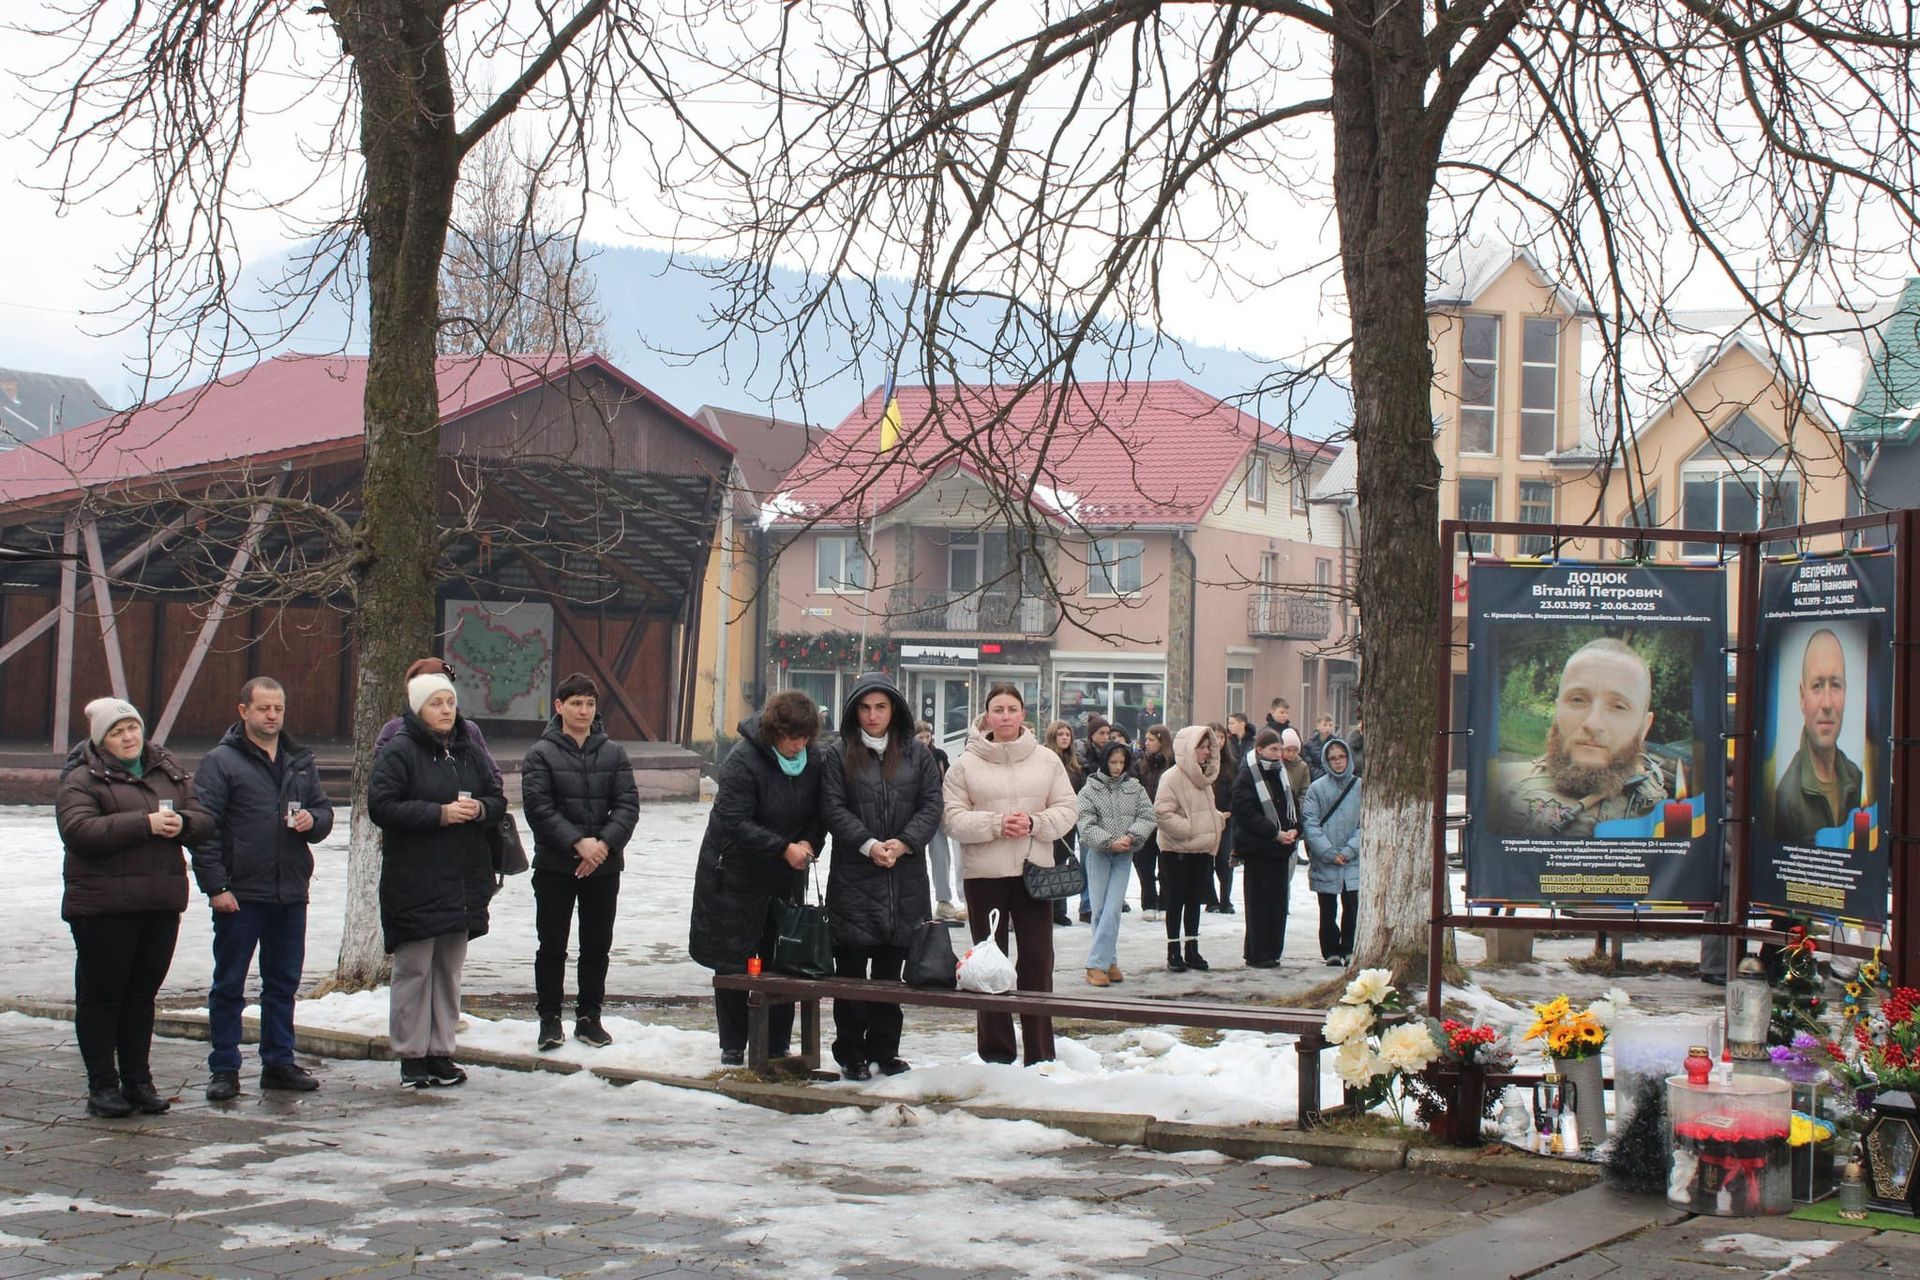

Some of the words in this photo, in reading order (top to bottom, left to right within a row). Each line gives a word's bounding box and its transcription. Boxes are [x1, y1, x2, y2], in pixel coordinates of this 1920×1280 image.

[1800, 563, 1848, 578] ВЕПРЕЙЧУК
[1567, 571, 1627, 585] ДОДЮК
[1532, 584, 1586, 597] Віталій
[1590, 586, 1663, 599] Петрович
[1792, 579, 1821, 593] Віталій
[1822, 579, 1858, 592] Іванович
[1540, 601, 1592, 610] 23.03.1992
[1600, 602, 1656, 611] 20.06.2025
[1540, 874, 1582, 884] НИЗЬКИЙ
[1583, 873, 1620, 884] ЗЕМНИЙ
[1540, 884, 1582, 893] ВІРНОМУ
[1583, 884, 1608, 893] СИНУ
[1608, 884, 1648, 894] УКРАЇНИ
